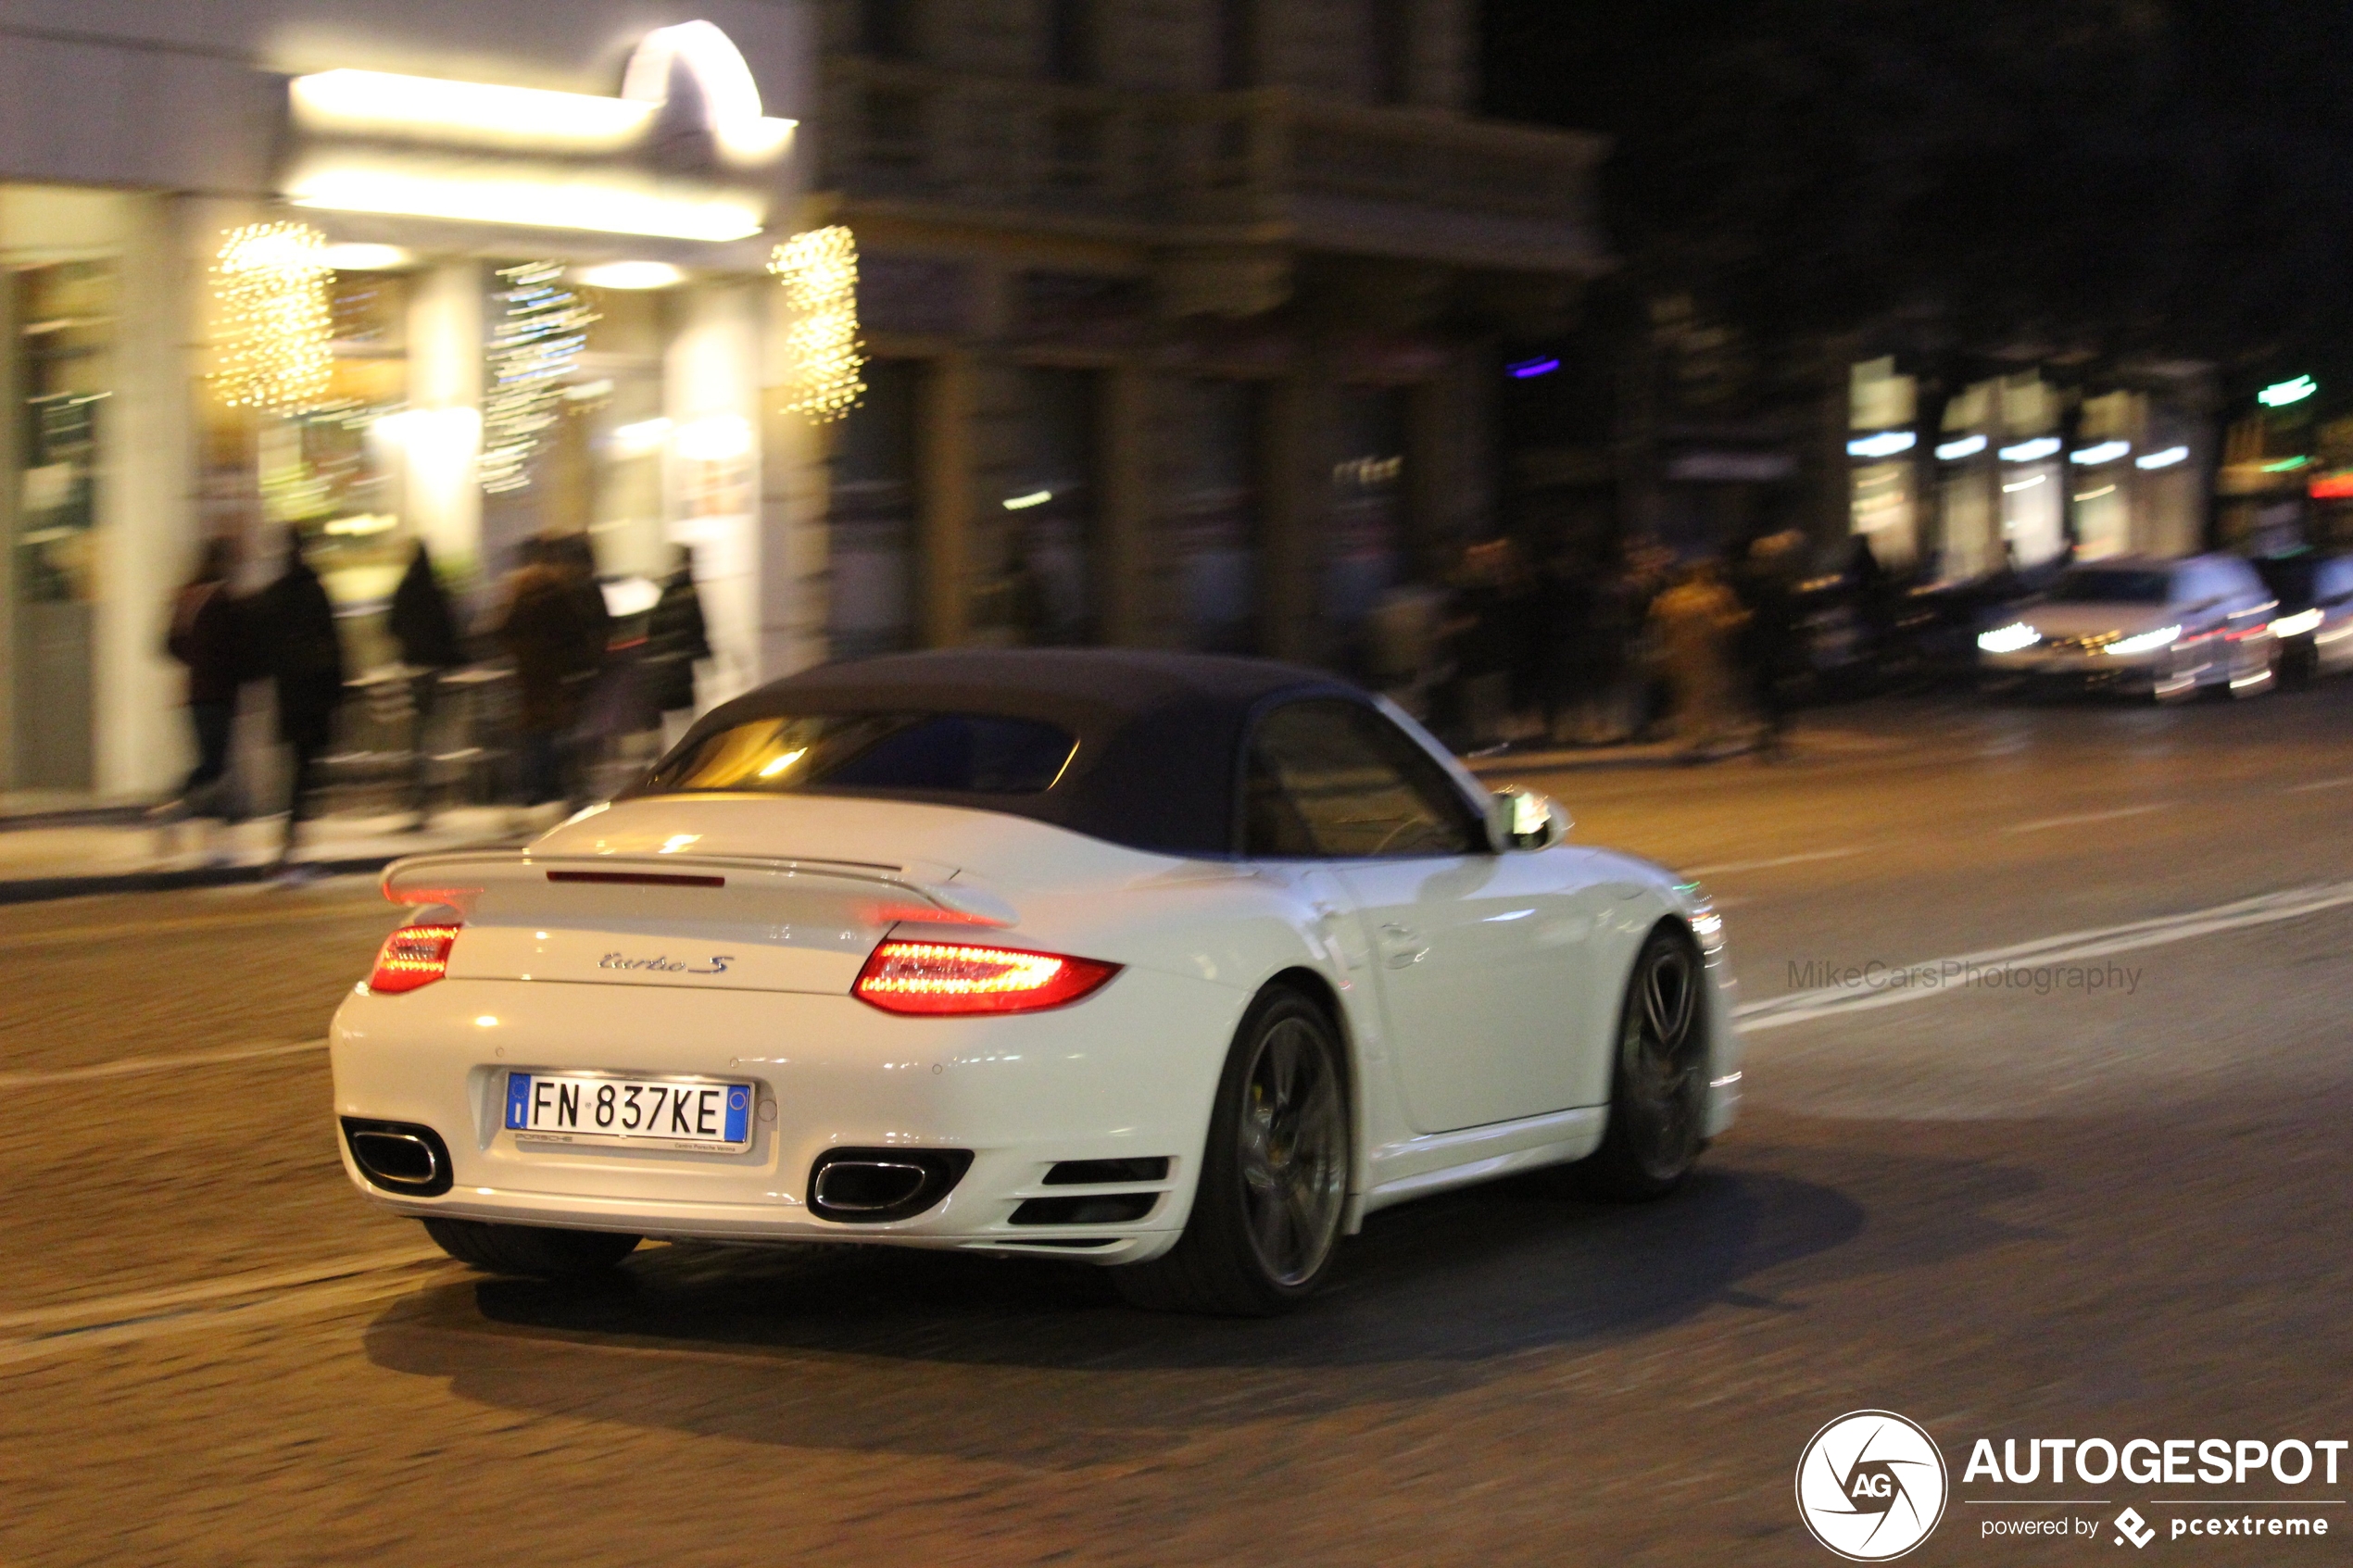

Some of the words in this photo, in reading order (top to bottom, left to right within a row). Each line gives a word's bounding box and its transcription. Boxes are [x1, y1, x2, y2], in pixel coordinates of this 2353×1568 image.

[598, 952, 686, 972] turbo
[534, 1083, 579, 1126] FN
[596, 1085, 720, 1134] 837KE
[515, 1134, 573, 1142] PORSCHE
